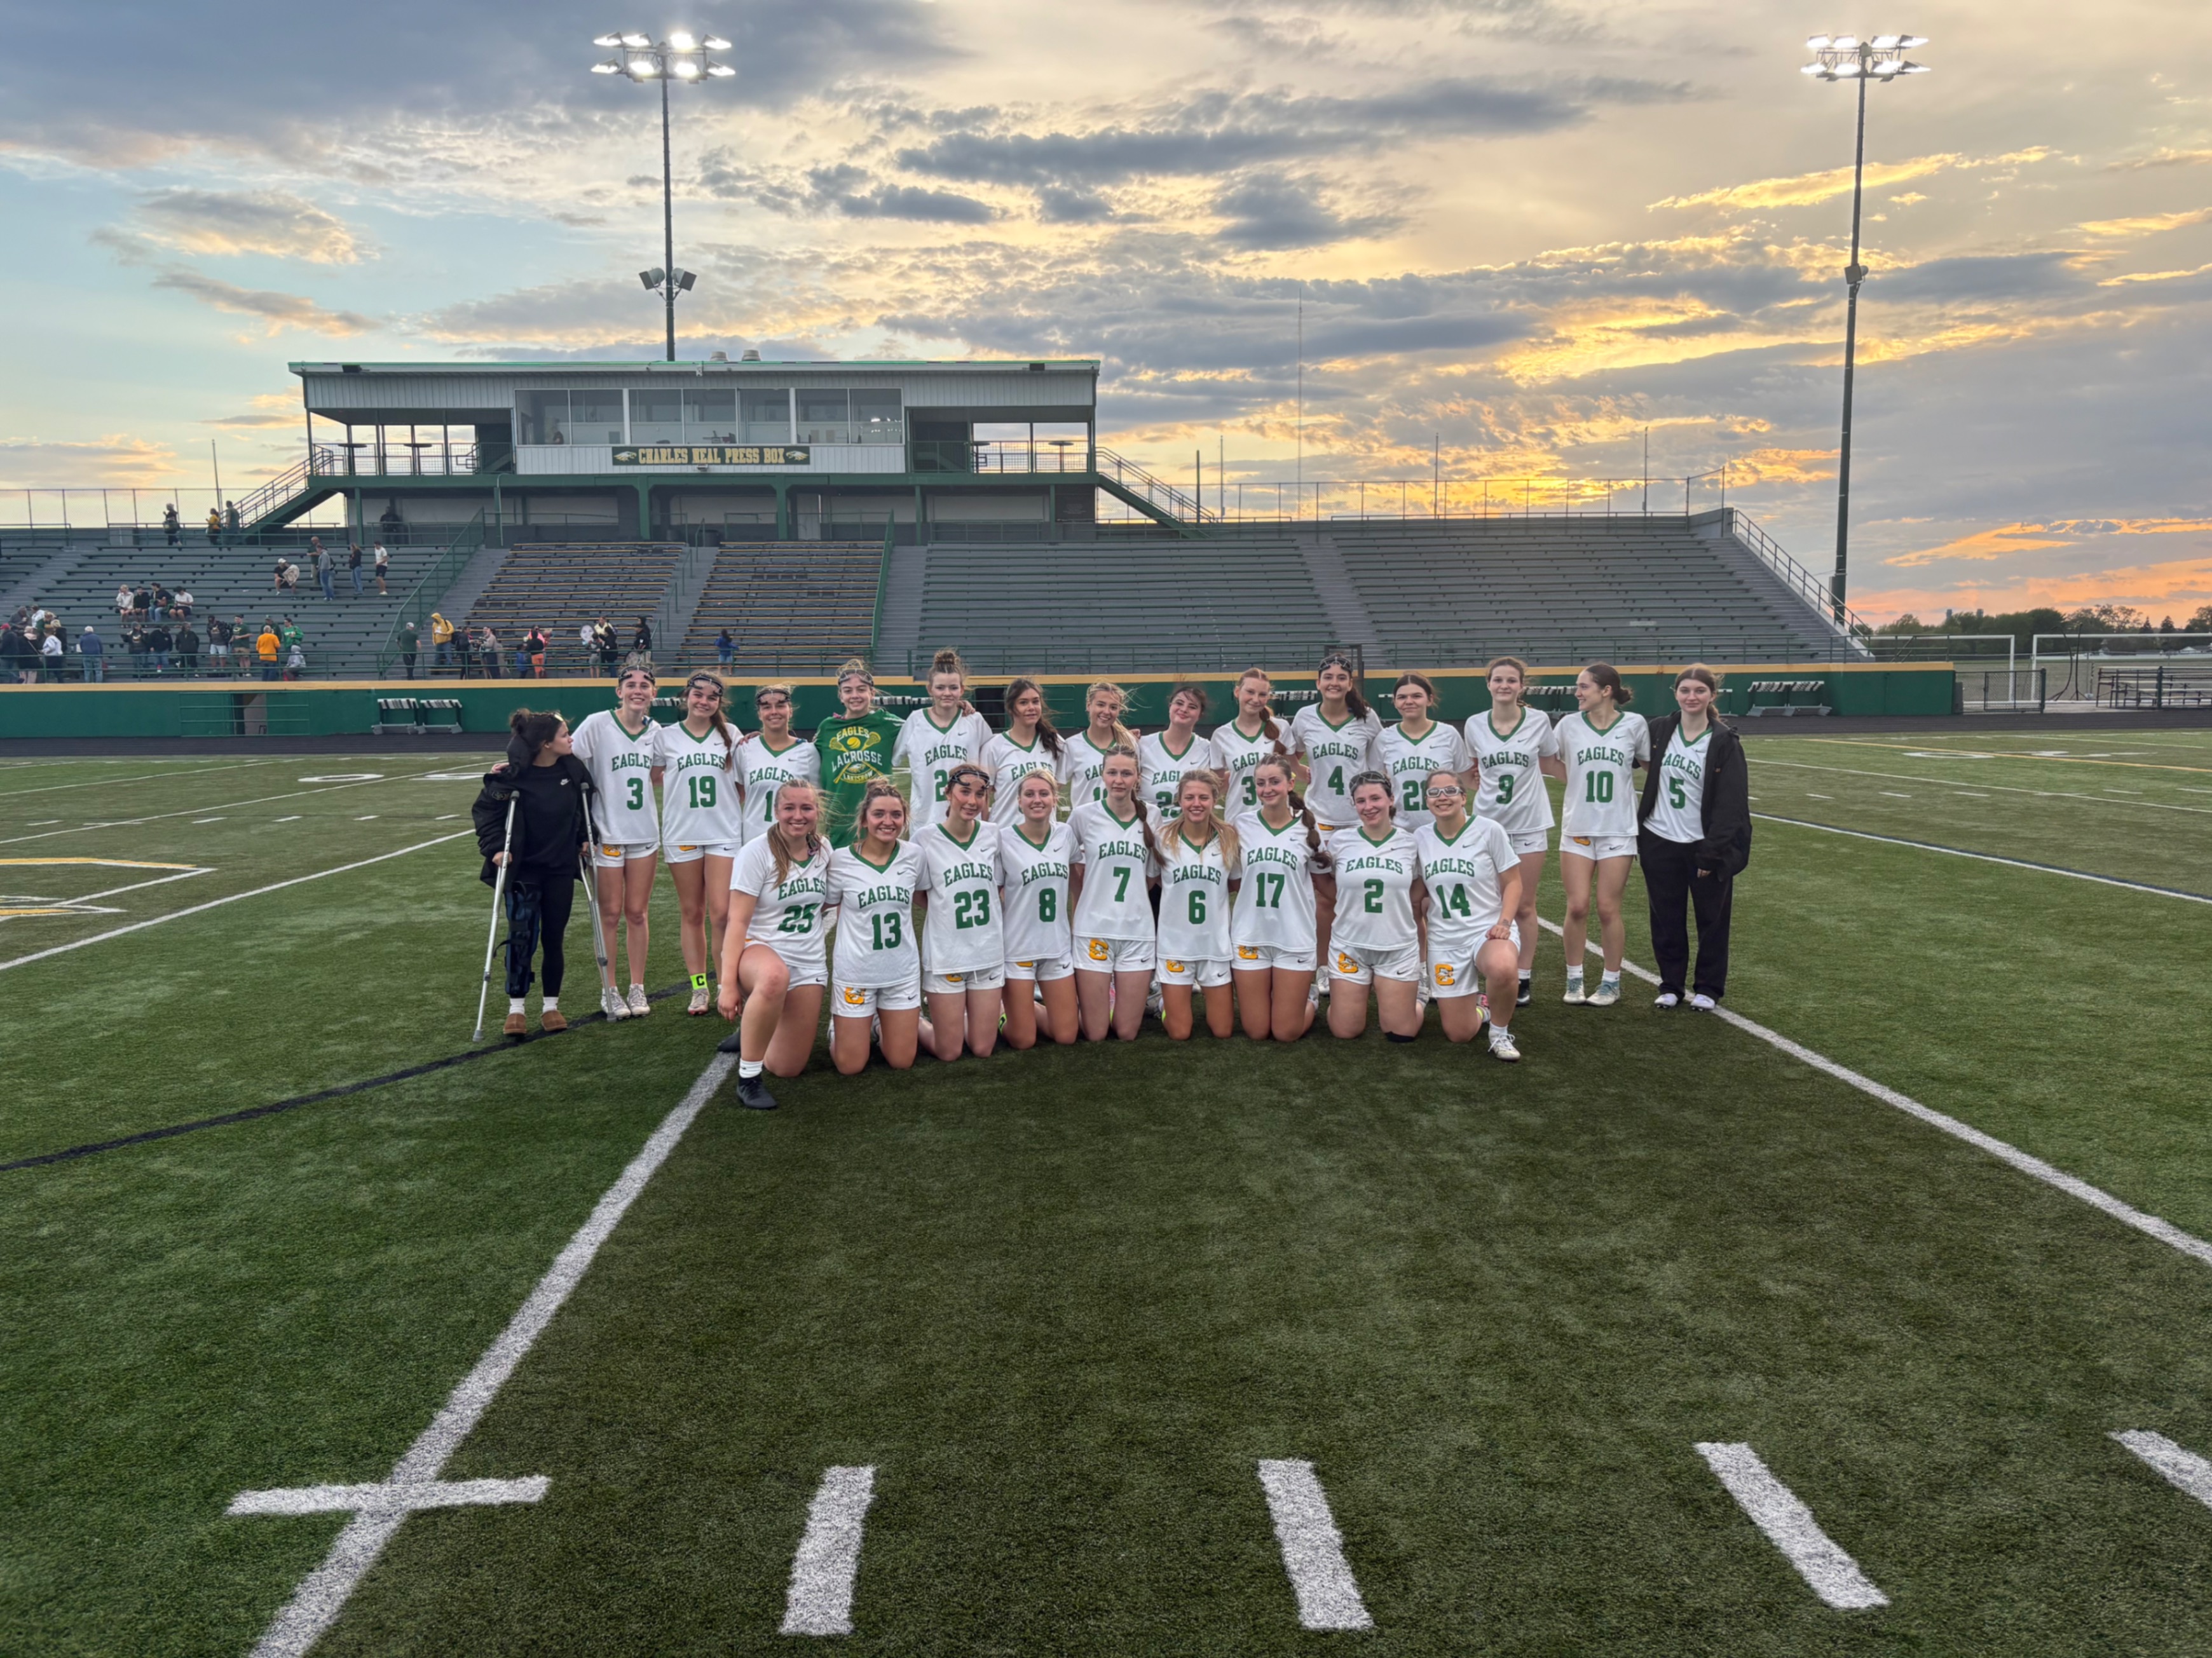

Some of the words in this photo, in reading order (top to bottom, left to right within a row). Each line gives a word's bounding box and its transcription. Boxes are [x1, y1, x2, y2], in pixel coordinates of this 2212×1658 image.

[638, 448, 688, 464] CHARLES
[692, 448, 721, 464] NEAL
[725, 448, 760, 464] PRESS
[763, 448, 785, 464] BOX
[836, 726, 870, 742] EAGLES
[677, 753, 725, 771] EAGLES
[831, 750, 882, 773] LACROSSE
[924, 745, 967, 766] EAGLES
[1313, 742, 1358, 760] EAGLES
[1482, 751, 1529, 770] EAGLES
[1578, 746, 1625, 766] EAGLES
[1663, 753, 1702, 780] AGLES
[627, 777, 643, 810] 3
[688, 775, 716, 808] 19
[1241, 775, 1264, 806] 3
[1328, 766, 1344, 795] 4
[1496, 774, 1514, 805] 9
[1586, 770, 1613, 803] 10
[1669, 776, 1686, 809] 5
[1098, 841, 1147, 863] EAGLES
[1247, 847, 1297, 871] EAGLES
[943, 862, 993, 888] EAGLES
[1021, 862, 1068, 887] EAGLES
[1173, 864, 1221, 885] EAGLES
[1345, 857, 1403, 874] EAGLES
[1425, 858, 1475, 880] EAGLES
[778, 877, 826, 900] EAGLES
[858, 885, 910, 909] EAGLES
[1113, 866, 1131, 902] 7
[1256, 872, 1285, 909] 17
[1363, 879, 1384, 913] 2
[953, 888, 990, 930] 23
[1039, 888, 1056, 922] 8
[1189, 890, 1206, 925] 6
[1435, 883, 1471, 919] 14
[777, 902, 821, 934] 25
[871, 912, 901, 951] 13
[696, 975, 705, 986] C
